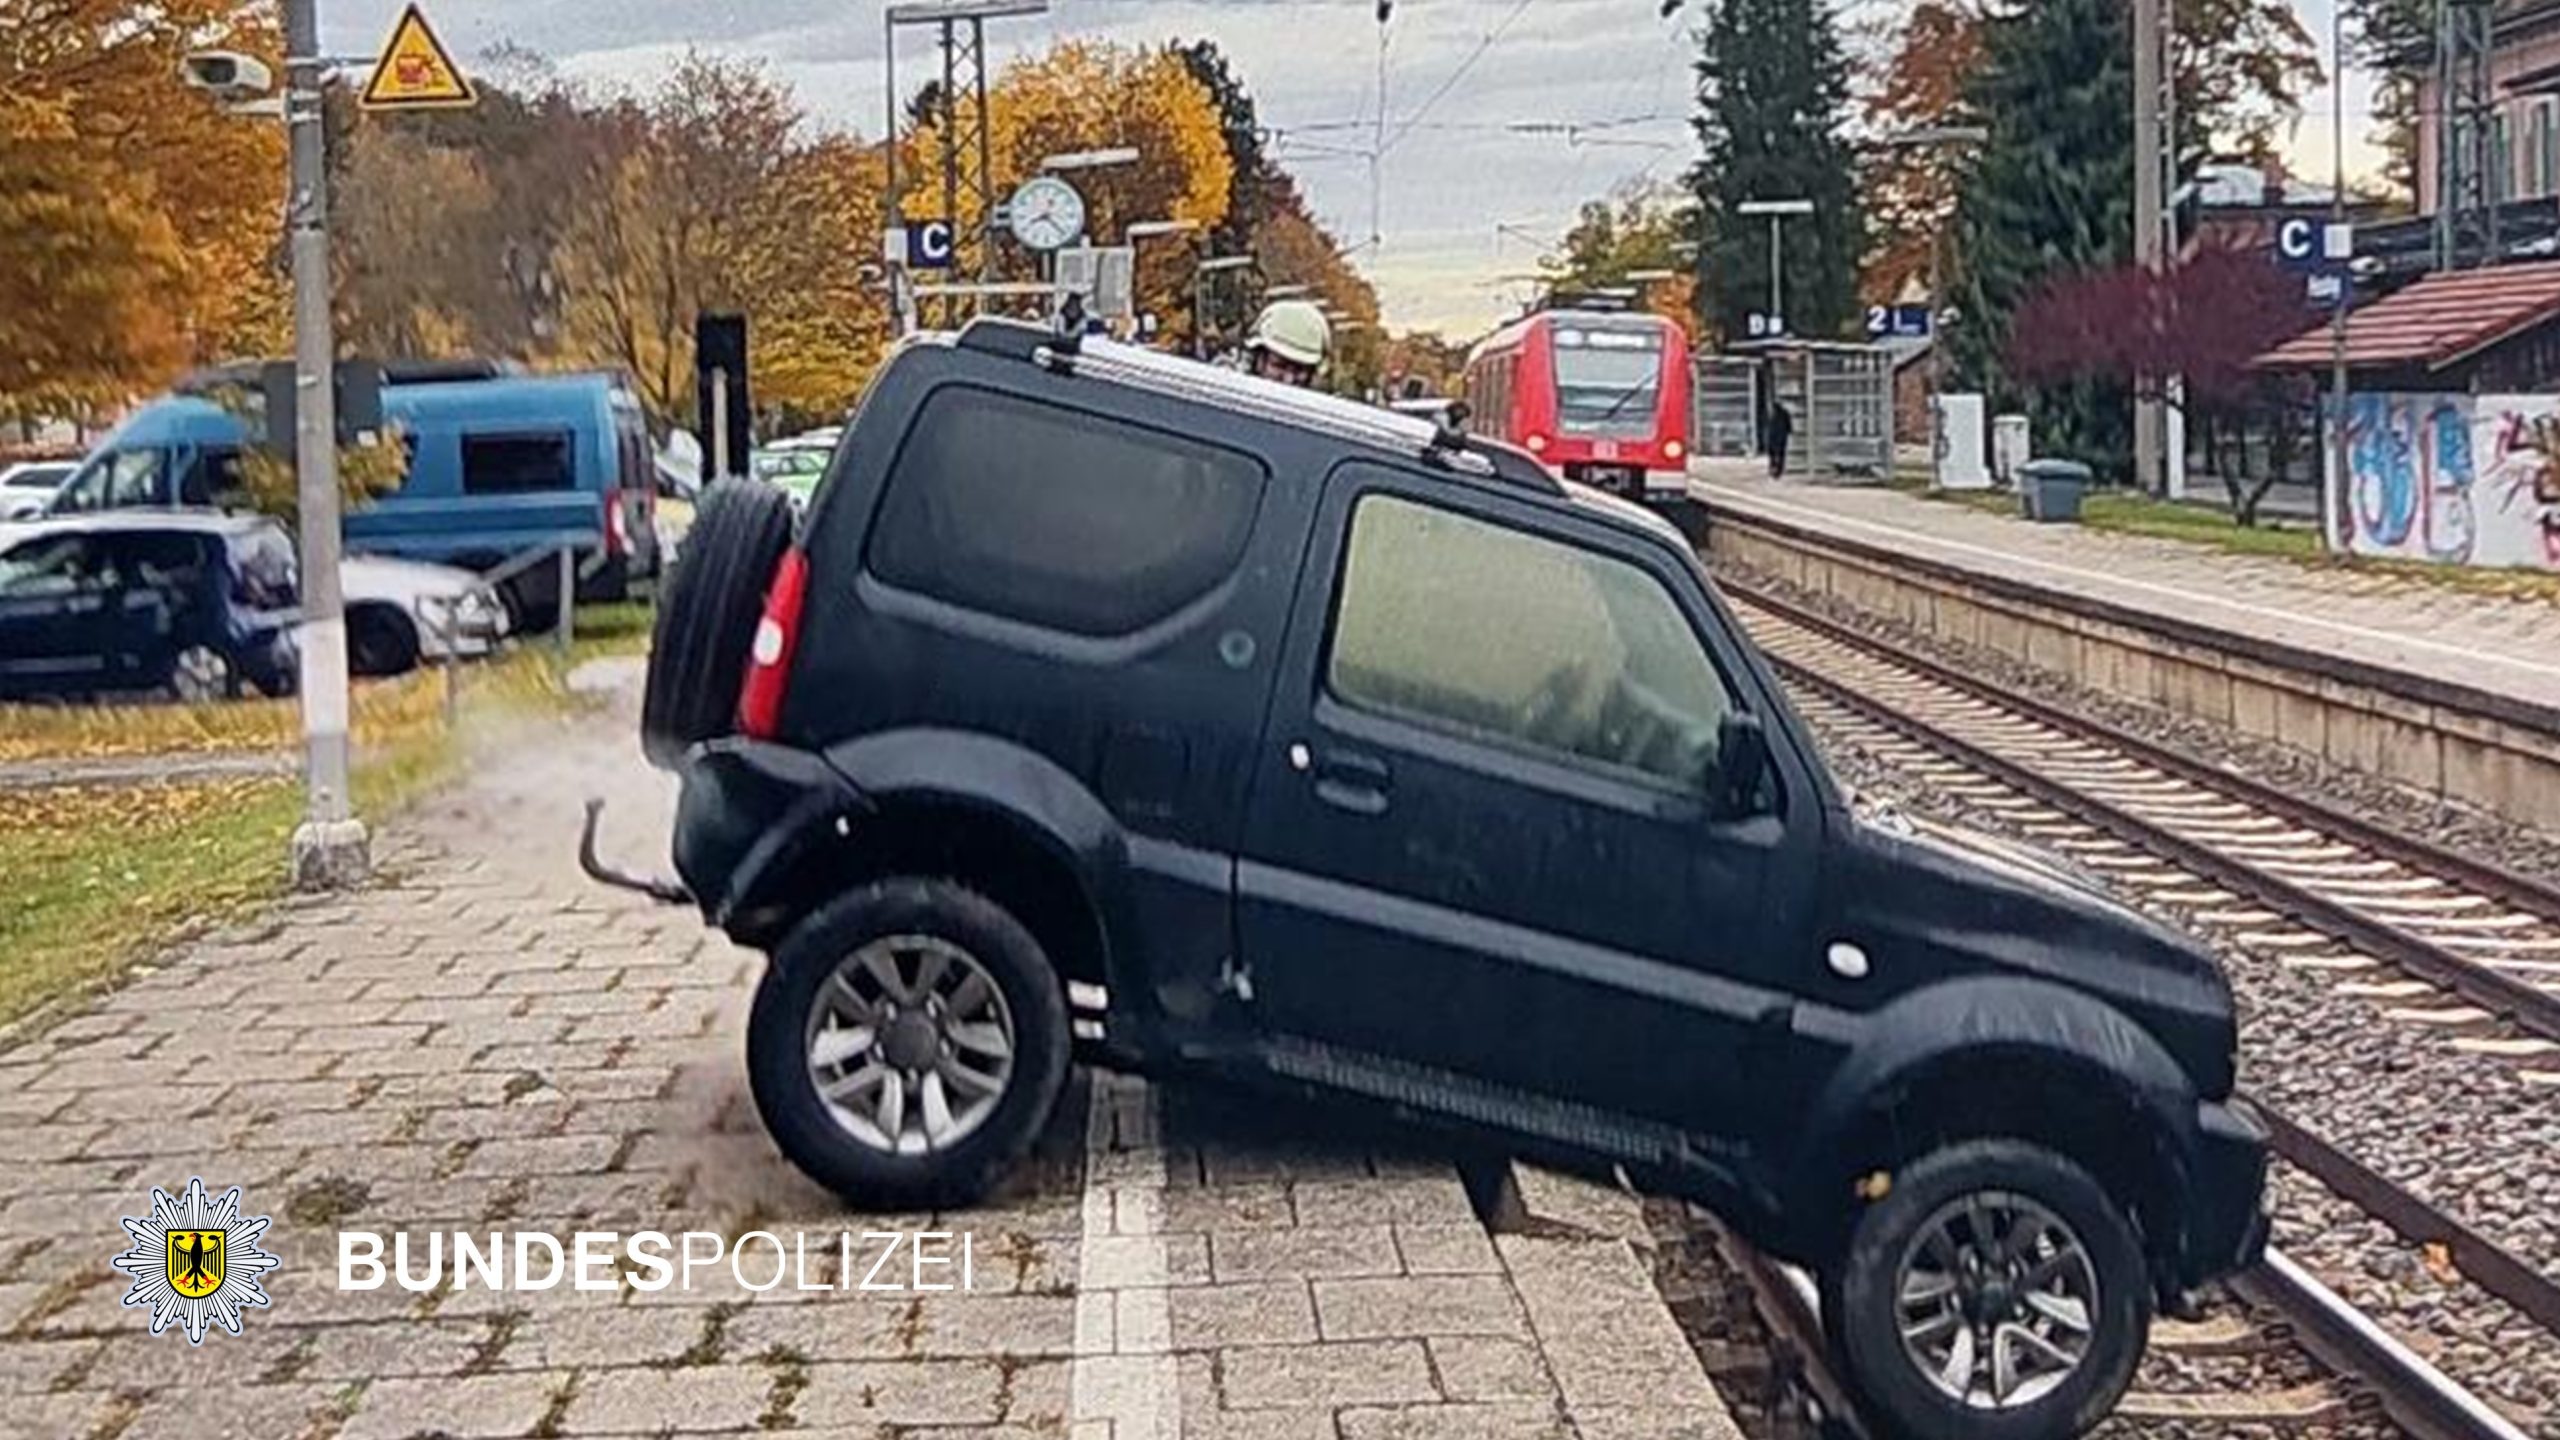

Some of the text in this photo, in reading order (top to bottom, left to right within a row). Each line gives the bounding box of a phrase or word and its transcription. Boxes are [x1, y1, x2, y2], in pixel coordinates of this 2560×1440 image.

[922, 222, 950, 258] C
[2281, 220, 2311, 257] C
[1867, 305, 1887, 332] 2
